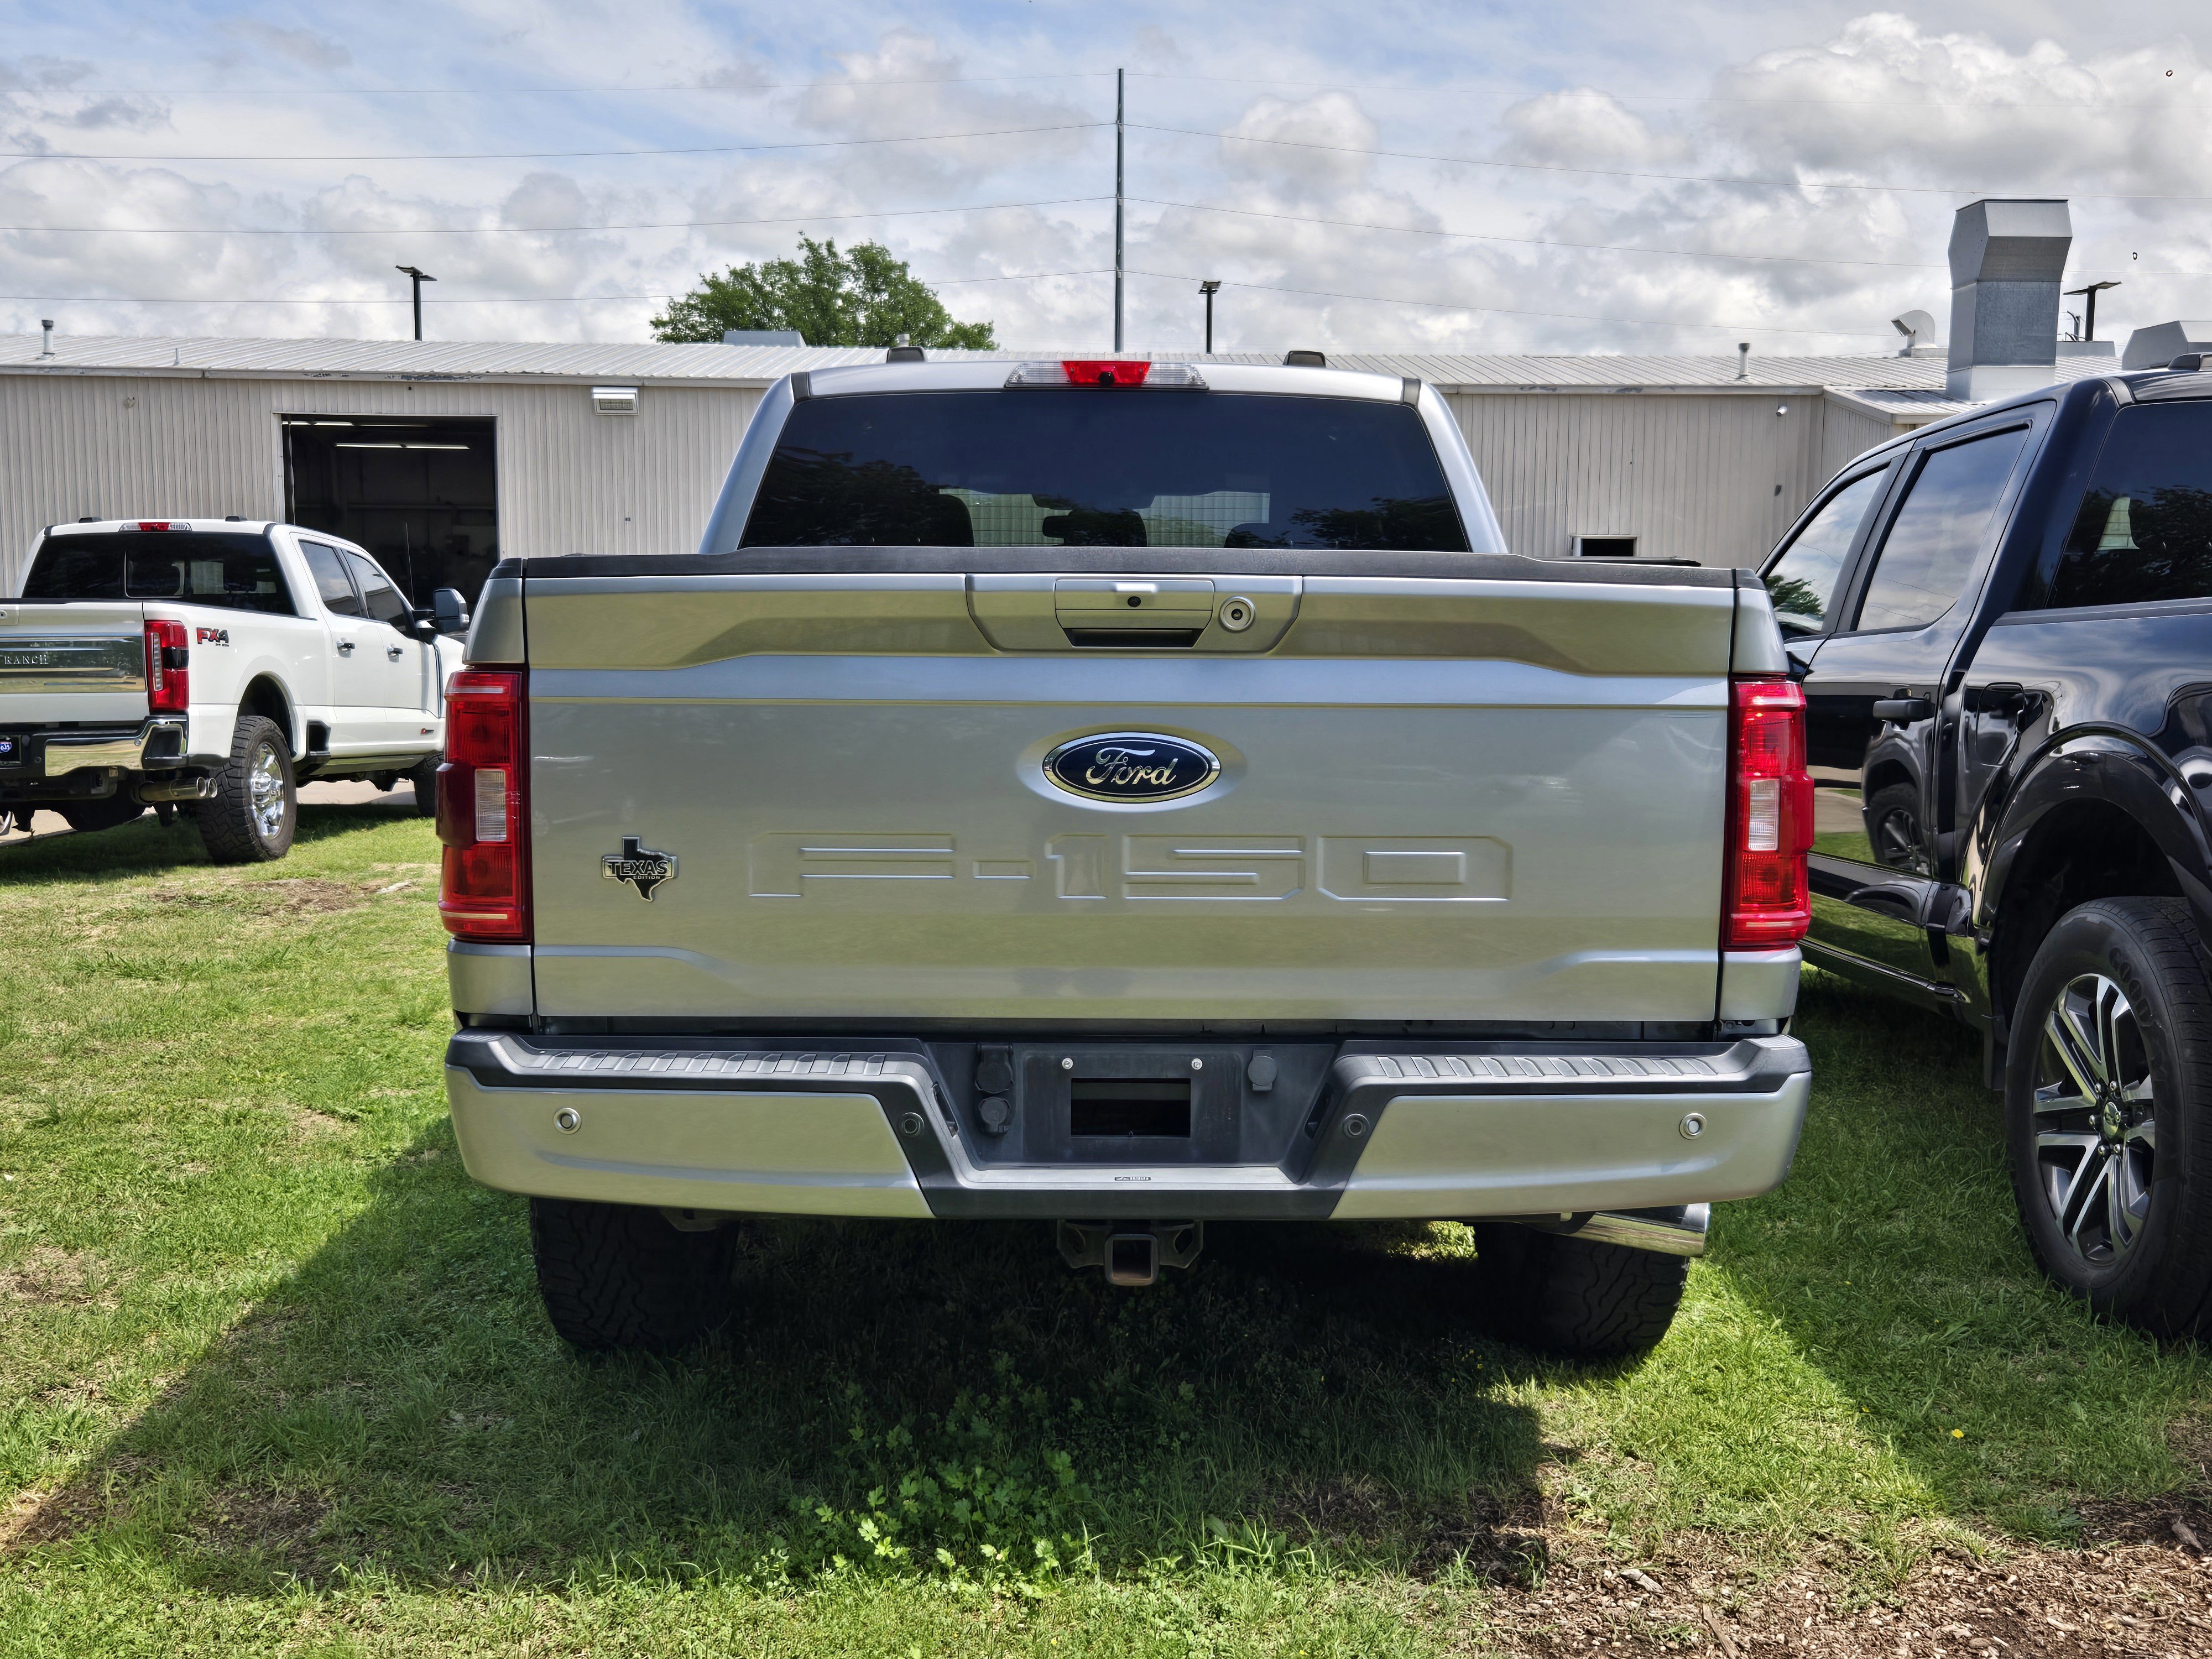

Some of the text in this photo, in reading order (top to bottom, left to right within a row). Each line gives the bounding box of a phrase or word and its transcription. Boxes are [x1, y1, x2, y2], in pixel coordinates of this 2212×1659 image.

[196, 627, 229, 645] FX4
[4, 654, 49, 664] RANCH
[1086, 747, 1178, 785] Ford
[608, 860, 669, 875] TEXAS
[749, 832, 1513, 901] F-150
